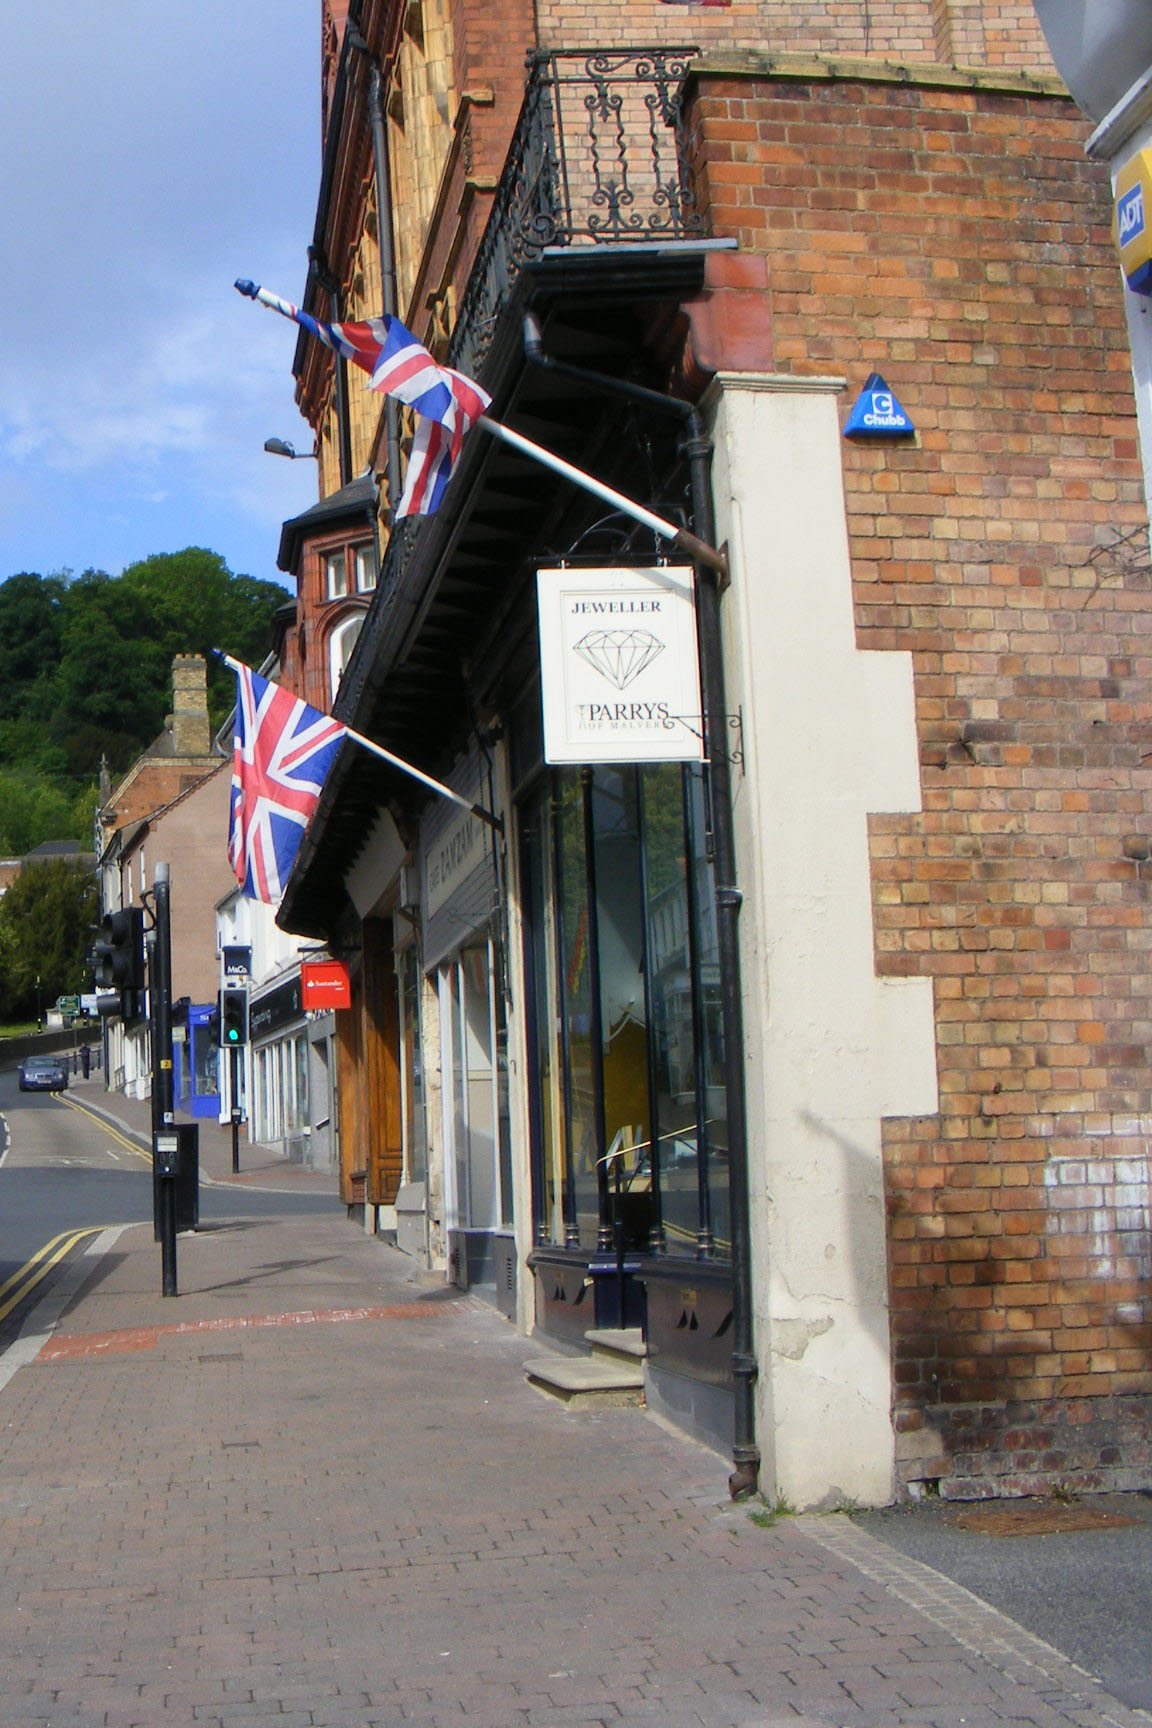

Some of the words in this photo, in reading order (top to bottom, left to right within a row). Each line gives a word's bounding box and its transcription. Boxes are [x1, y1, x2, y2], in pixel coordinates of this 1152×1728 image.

[1120, 193, 1142, 237] ADT
[864, 414, 905, 426] Chubb
[572, 601, 661, 614] JEWELLER
[590, 702, 669, 722] PARRYS
[610, 720, 671, 730] MALVER
